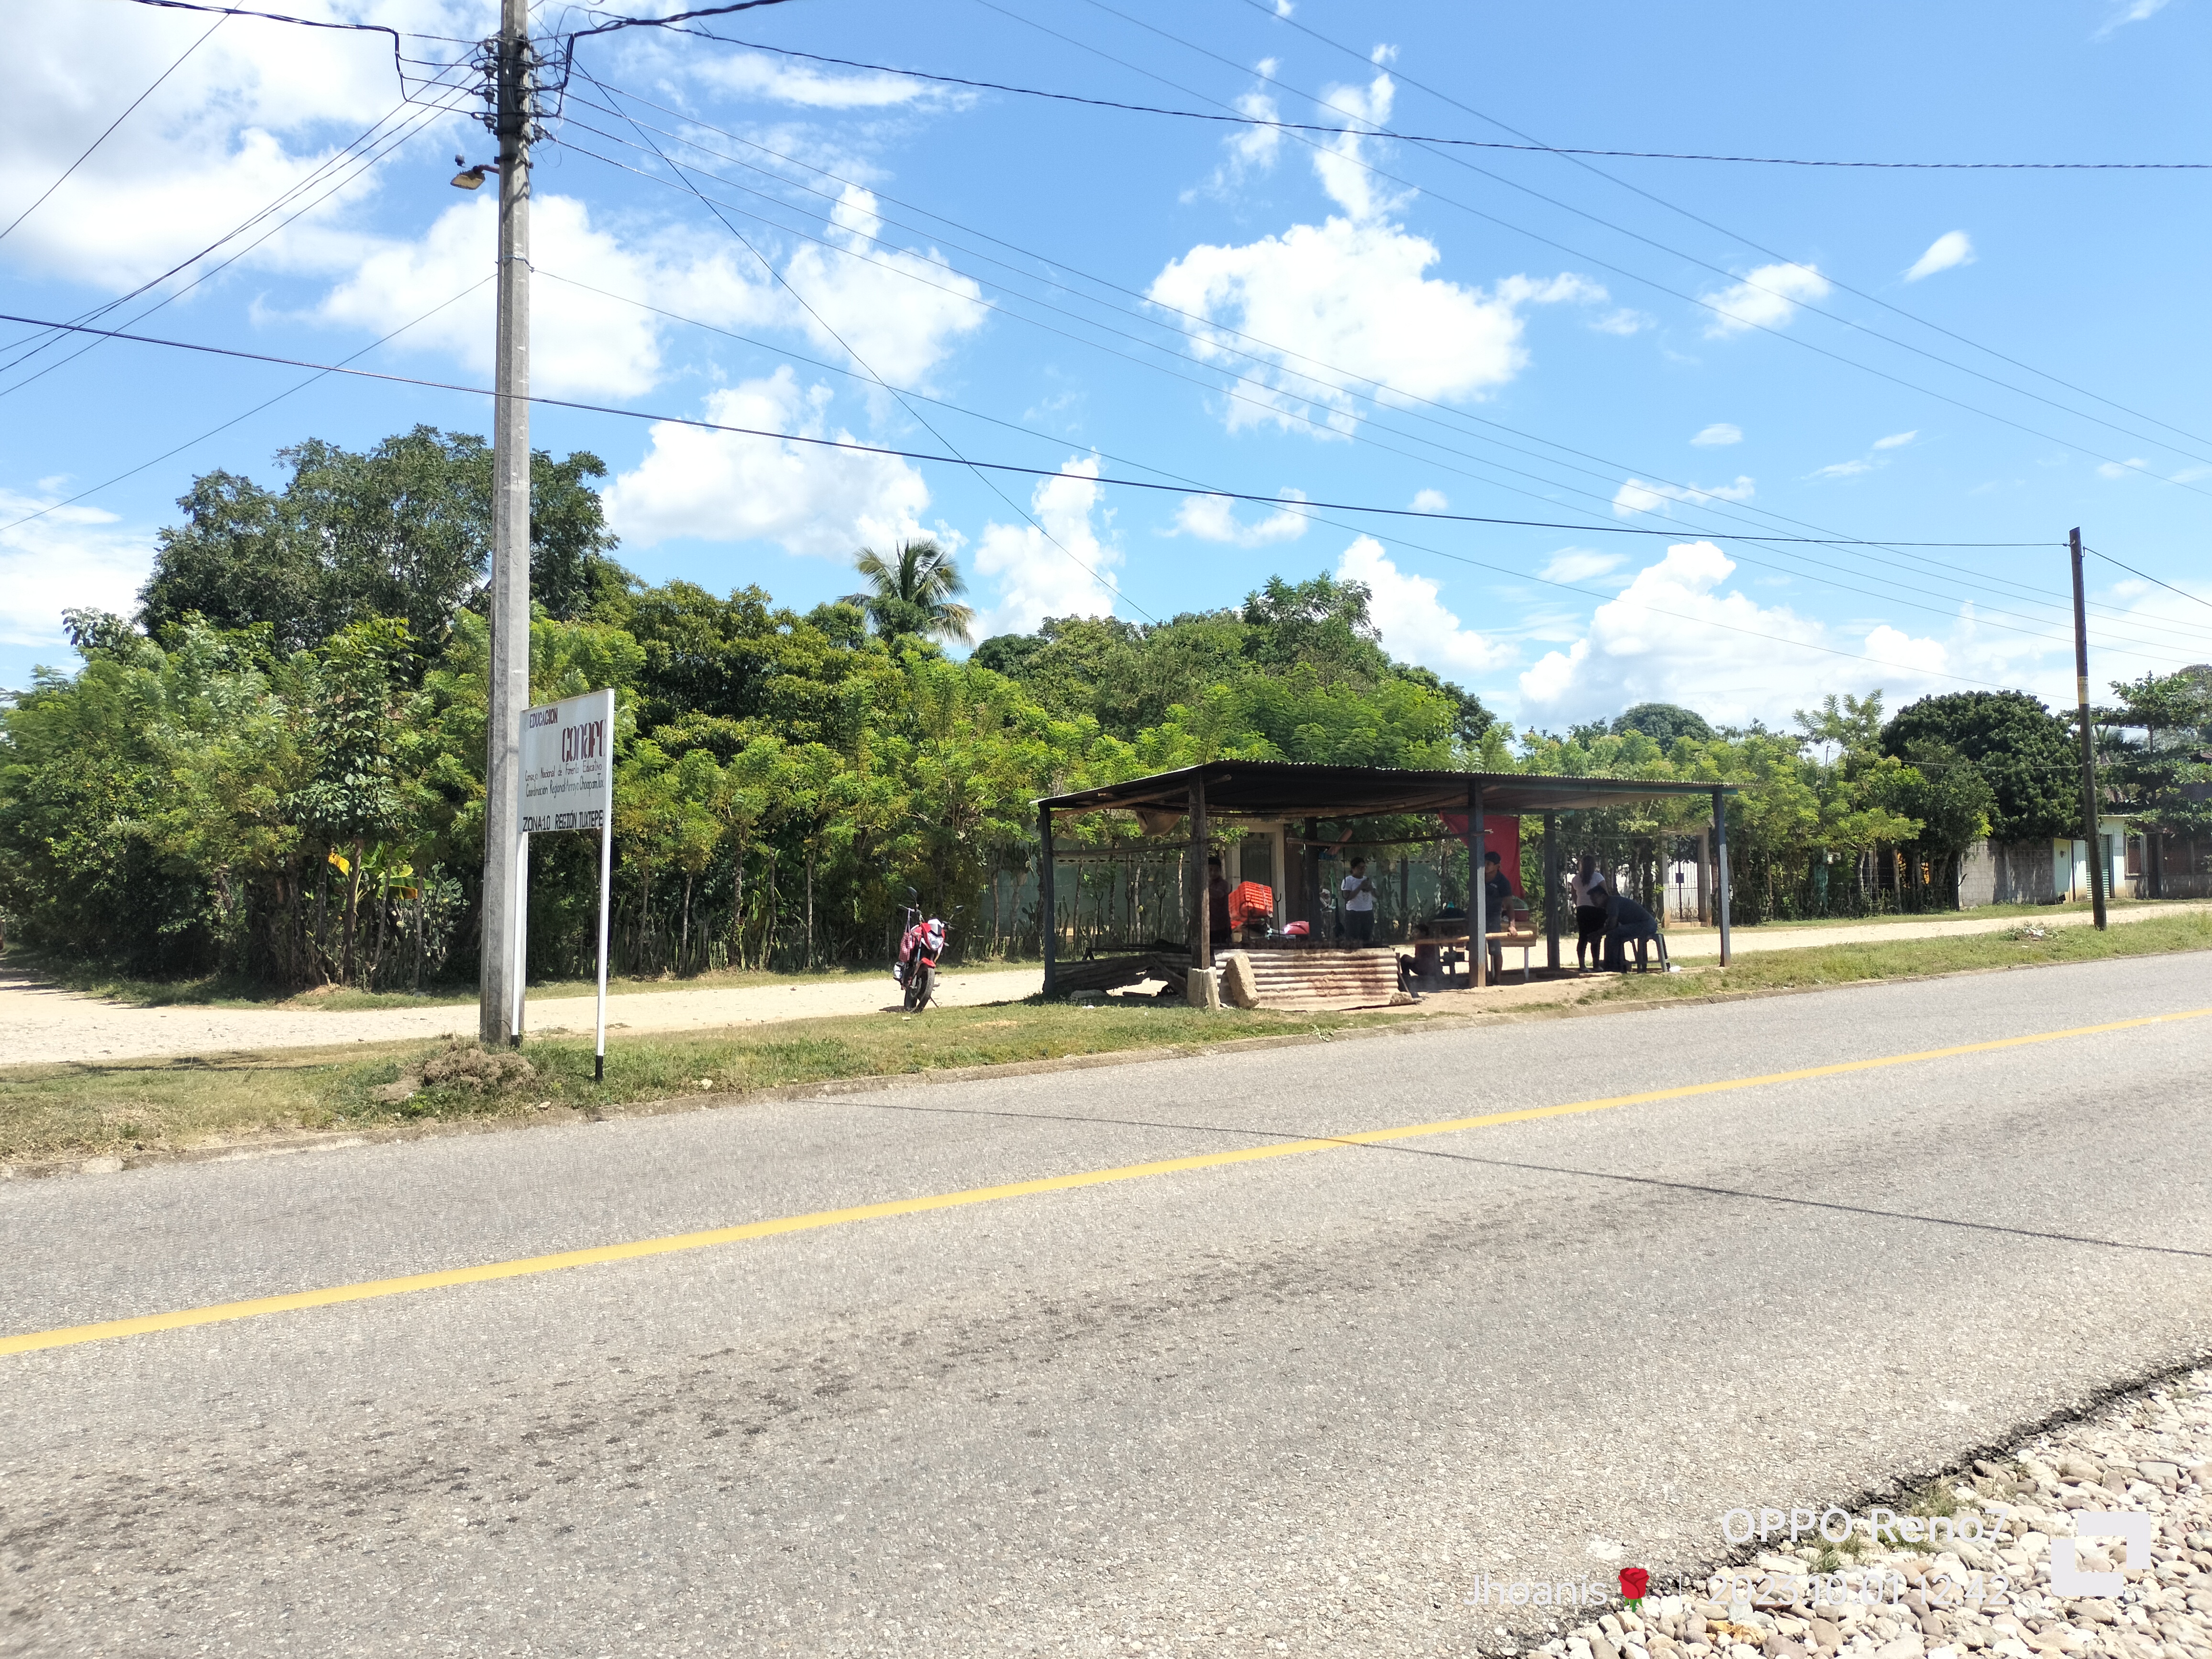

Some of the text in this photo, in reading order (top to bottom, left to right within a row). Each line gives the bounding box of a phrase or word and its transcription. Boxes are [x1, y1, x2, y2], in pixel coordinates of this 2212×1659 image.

[541, 765, 555, 778] Nacional
[557, 764, 562, 776] de
[554, 809, 577, 830] REGIÓN
[579, 809, 604, 828] TUXTEPE
